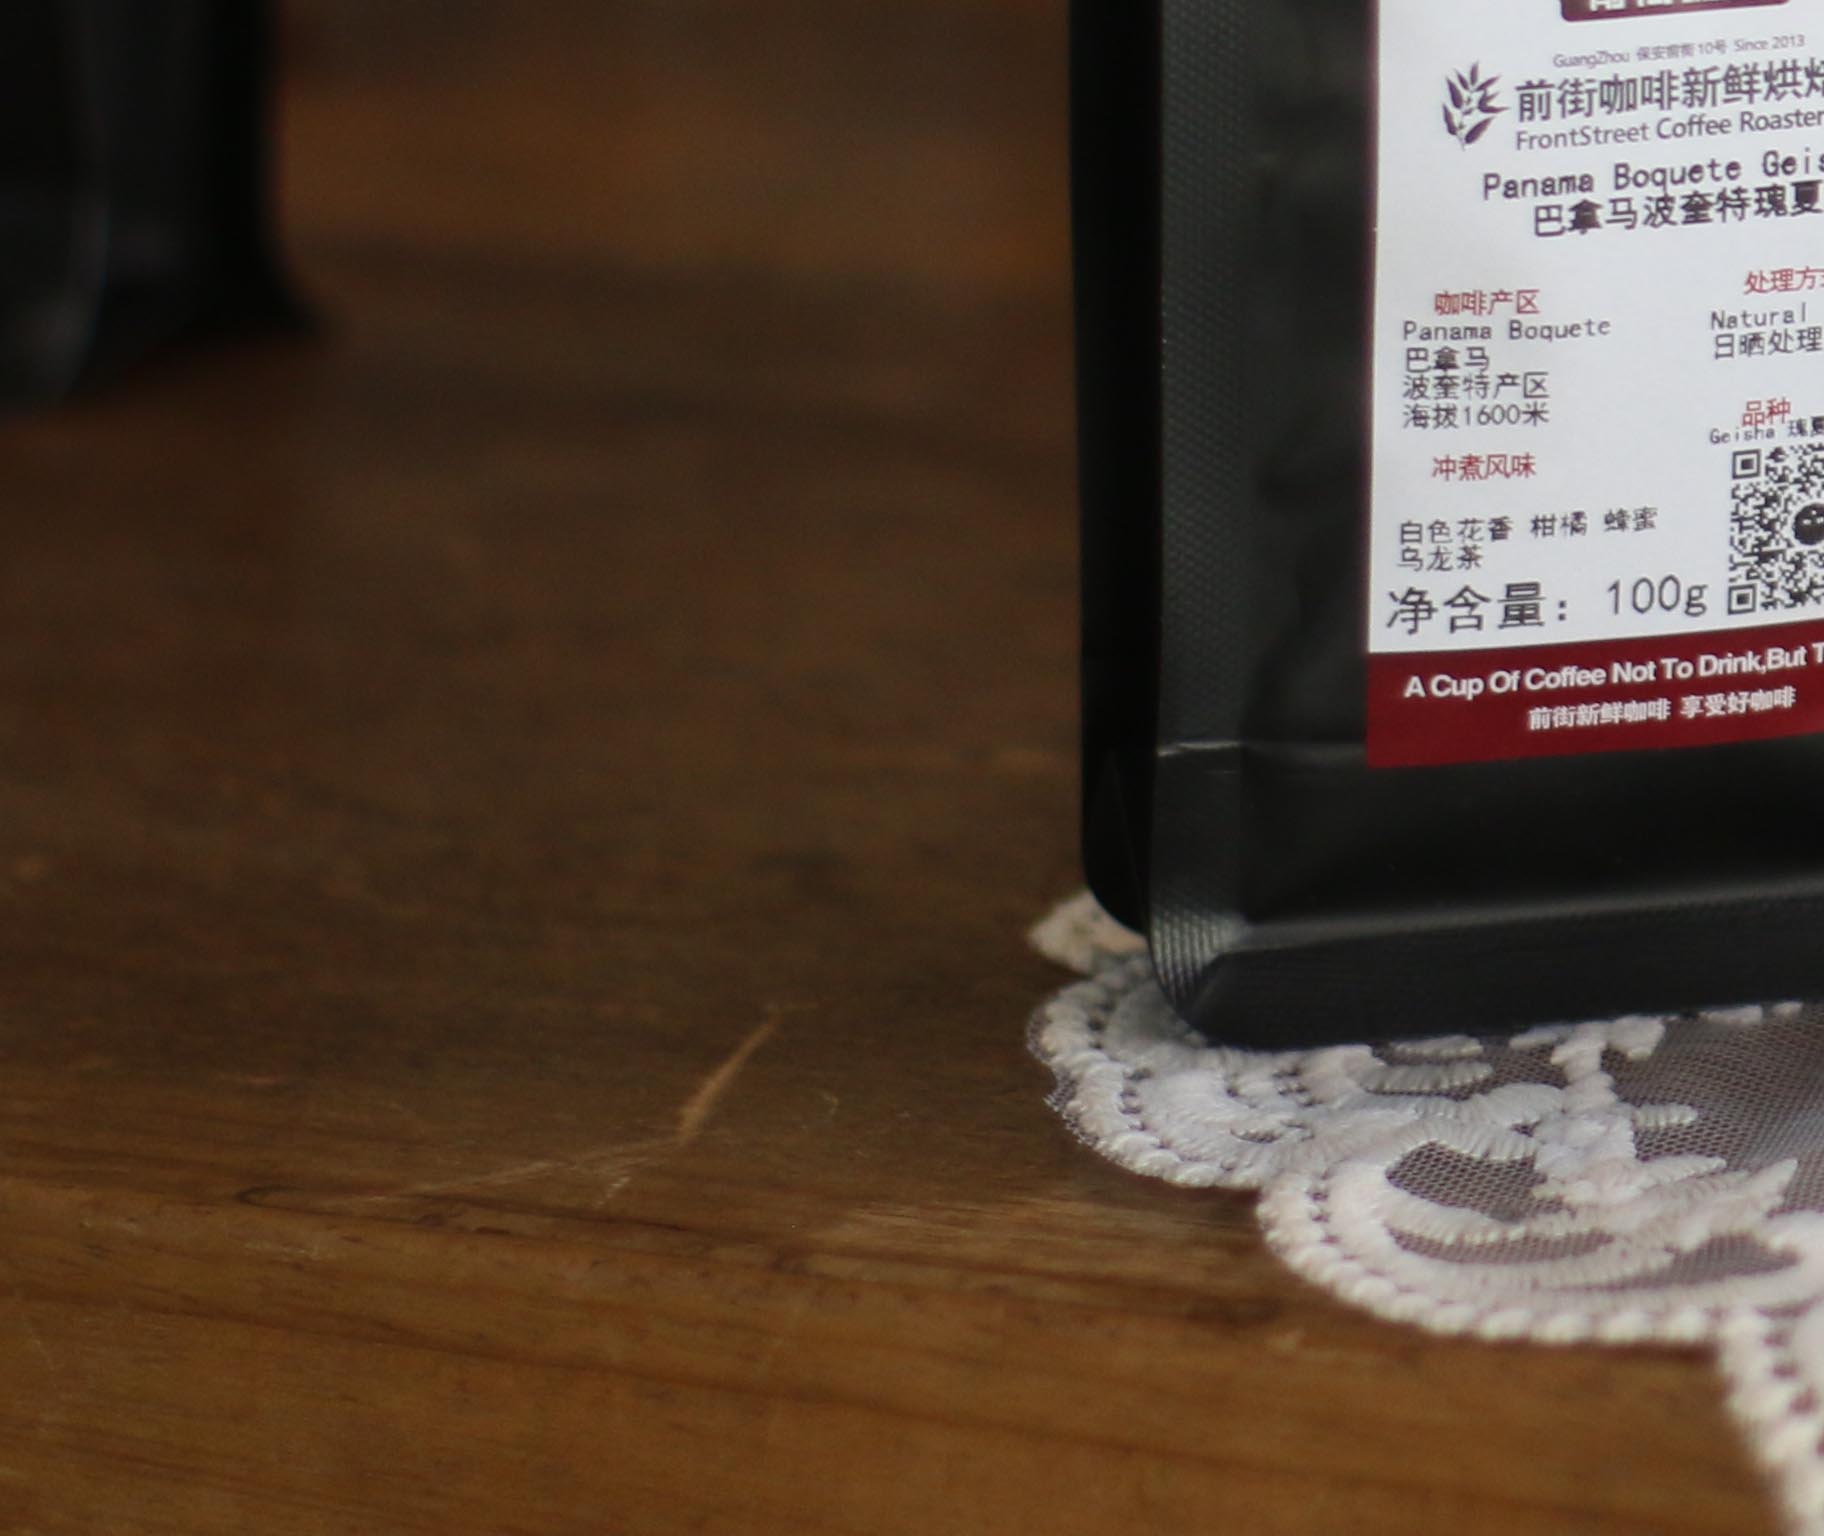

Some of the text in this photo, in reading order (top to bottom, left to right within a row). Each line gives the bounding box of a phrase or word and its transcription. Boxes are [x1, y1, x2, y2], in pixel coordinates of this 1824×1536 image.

[1553, 51, 1630, 69] GuangZhou
[1734, 39, 1769, 52] Since
[1772, 34, 1805, 49] 2013
[1516, 122, 1649, 151] FrontStreet
[1656, 115, 1731, 141] Coffee
[1483, 170, 1595, 199] Panama
[1614, 160, 1741, 193] Boquete
[1433, 289, 1540, 317] 咖啡产区
[1710, 303, 1807, 331] Natural
[1403, 316, 1611, 344] Panama Boquete
[1713, 326, 1823, 360] 日晒处理
[1405, 346, 1490, 372] 巴拿马
[1403, 370, 1550, 400] 波奎特产区
[1403, 402, 1550, 429] 海拔1600米
[1742, 397, 1791, 426] 品种
[1709, 425, 1775, 444] Geisha
[1432, 454, 1537, 480] 冲煮风味
[1400, 506, 1659, 545] 白色花香 柑橘 蜂蜜
[1399, 544, 1483, 572] 乌龙茶
[1607, 575, 1709, 617] 100g
[1404, 676, 1426, 698] A
[1430, 673, 1485, 700] Cup
[1488, 671, 1521, 694] Of
[1525, 664, 1605, 691] Coffee
[1612, 662, 1657, 684] Not
[1661, 659, 1694, 680] To
[1529, 686, 1796, 732] 前街新鲜咖啡 享受好咖啡
